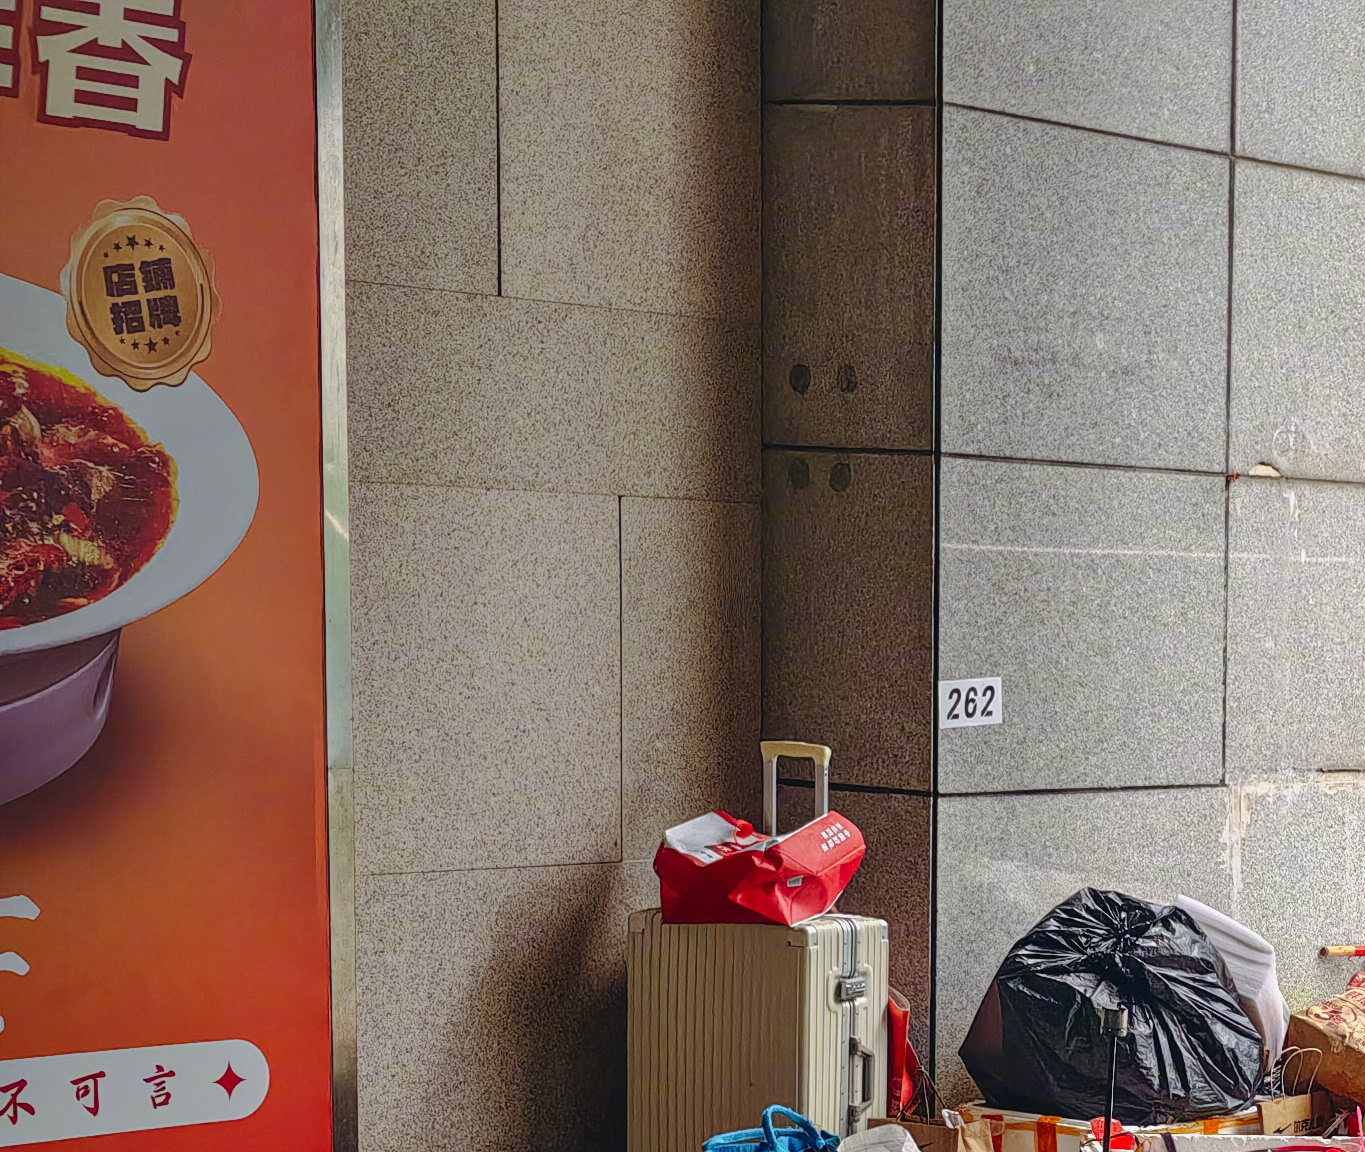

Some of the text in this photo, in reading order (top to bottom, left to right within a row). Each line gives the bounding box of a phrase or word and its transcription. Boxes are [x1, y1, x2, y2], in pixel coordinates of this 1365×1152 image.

[0, 0, 188, 138] 香
[110, 296, 182, 335] 招牌
[946, 685, 995, 720] 262
[0, 1065, 176, 1126] 不可言
